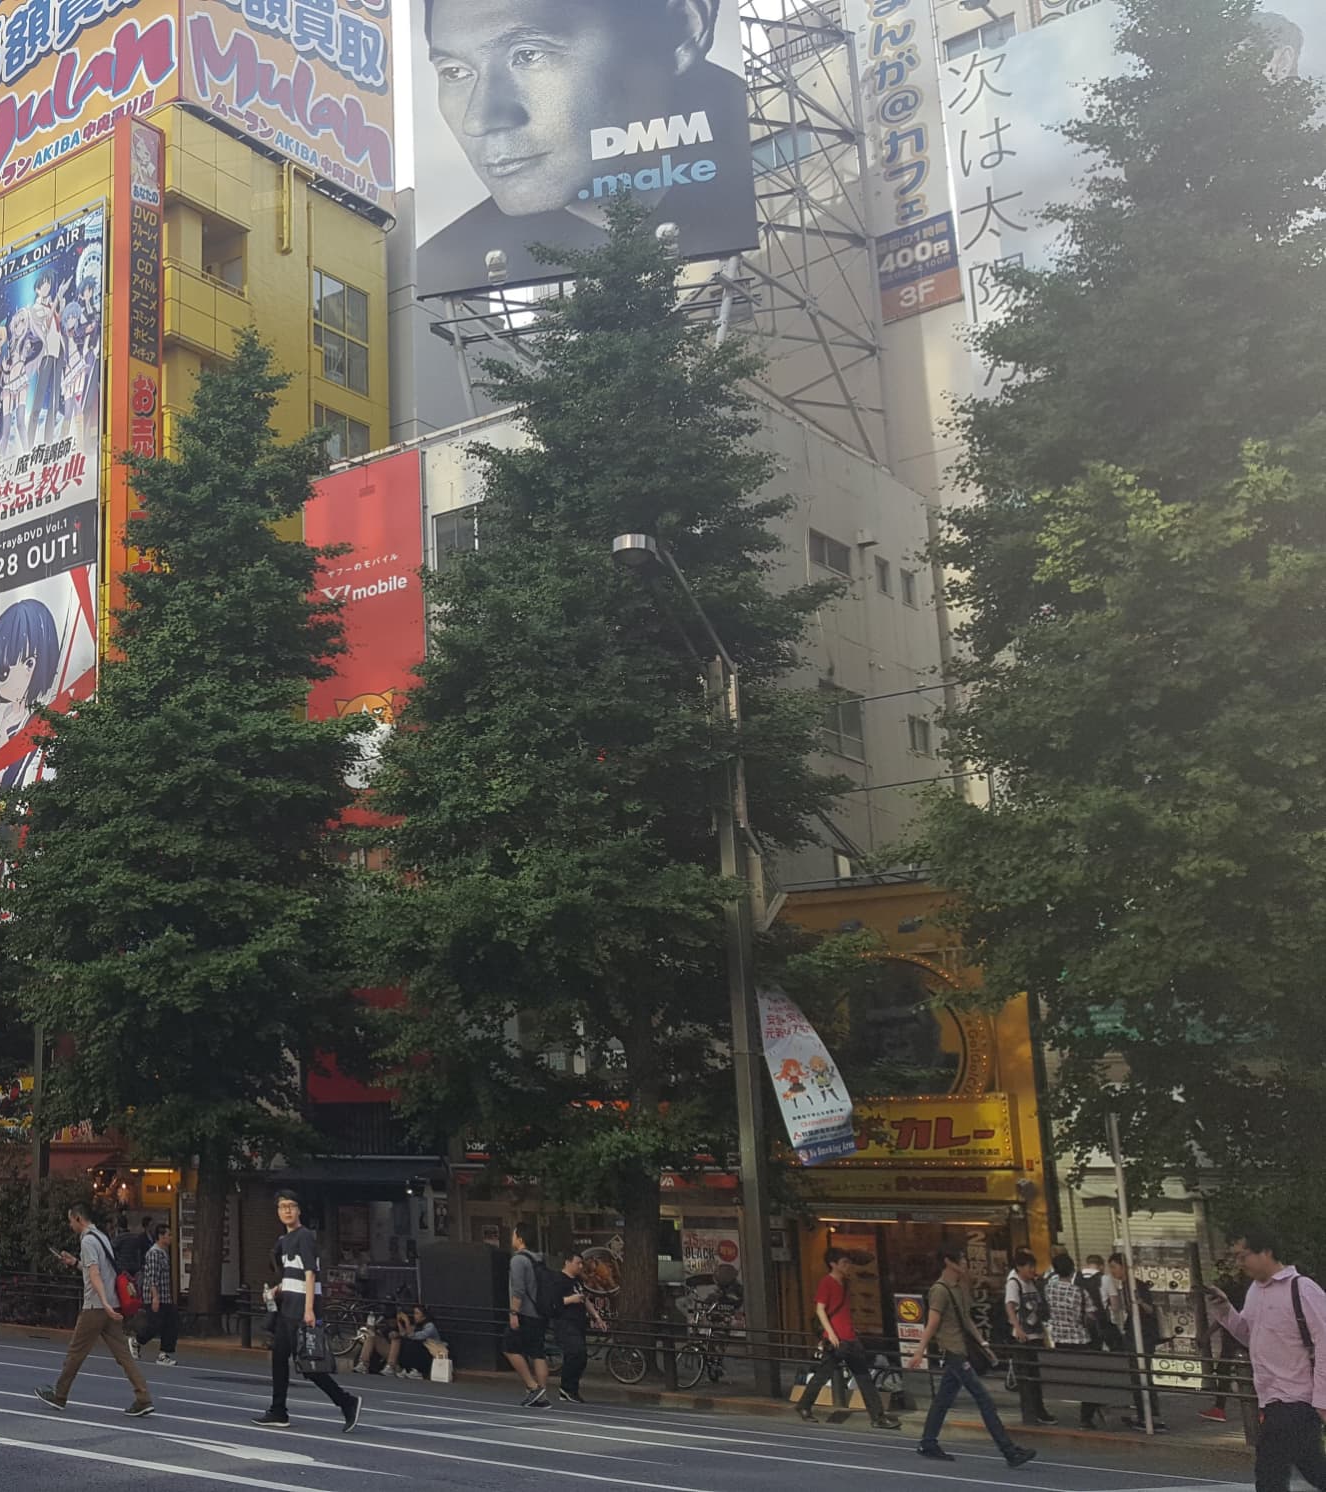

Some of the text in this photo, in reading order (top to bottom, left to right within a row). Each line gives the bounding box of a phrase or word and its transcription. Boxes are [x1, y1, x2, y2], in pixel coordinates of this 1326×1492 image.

[186, 12, 395, 190] Mulan
[871, 0, 928, 226] んが@カフェ
[211, 93, 274, 140] ムーラン
[274, 131, 319, 168] AKIBA
[590, 110, 714, 161] DMM
[32, 131, 81, 170] AKIBA
[577, 154, 717, 200] .make
[132, 184, 160, 205] あなたの
[134, 204, 158, 228] DVD
[32, 242, 52, 260] ON
[56, 227, 80, 250] AIR
[132, 221, 158, 243] ブルーレイ
[132, 238, 158, 262] ゲーム
[879, 239, 950, 273] 400円
[136, 257, 154, 276] CD
[132, 273, 158, 296] アイドル
[899, 278, 935, 308] 3F
[132, 290, 158, 311] アニメ
[132, 308, 157, 328] コミック
[132, 326, 155, 344] ホビー
[45, 517, 69, 536] Vol.1
[26, 531, 79, 570] OUT!
